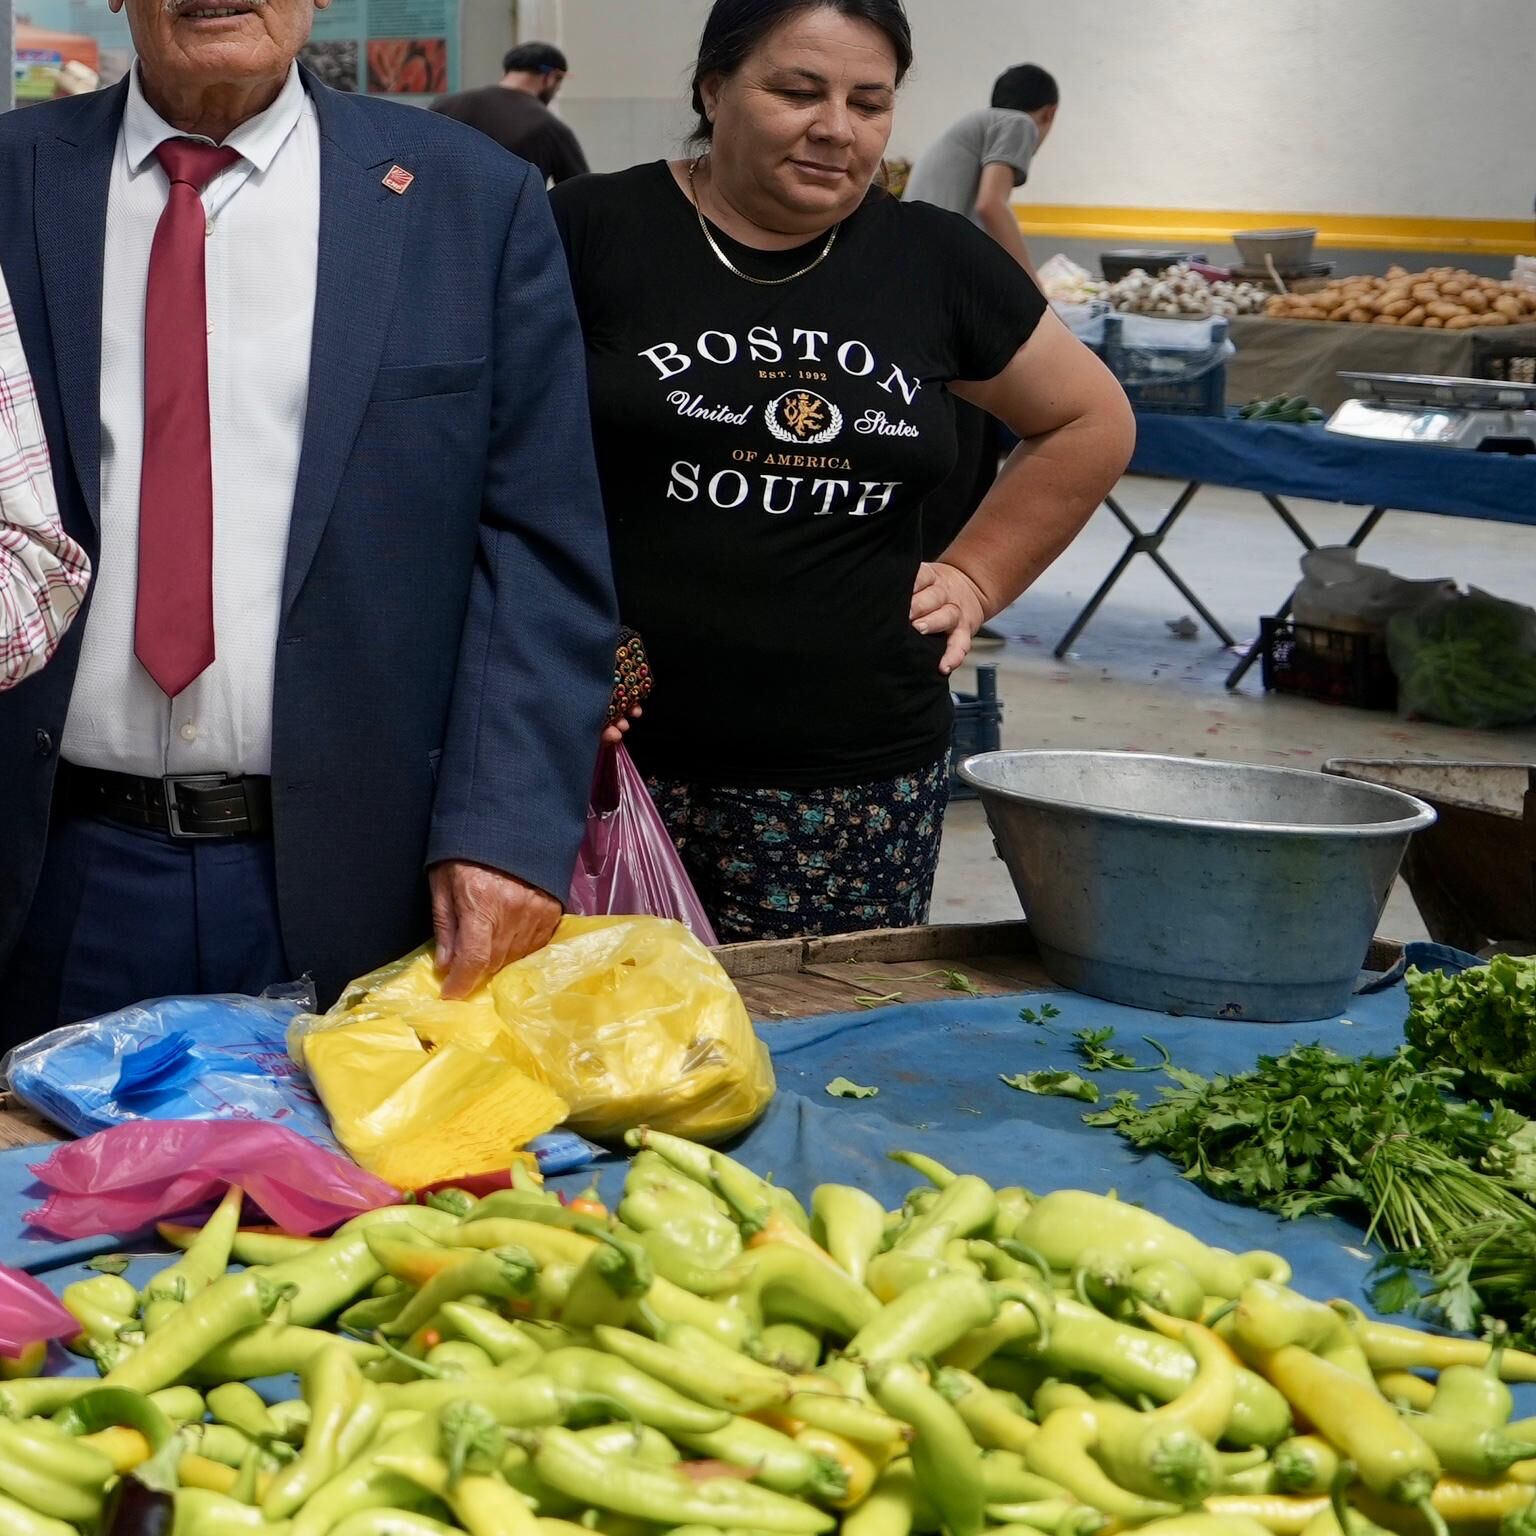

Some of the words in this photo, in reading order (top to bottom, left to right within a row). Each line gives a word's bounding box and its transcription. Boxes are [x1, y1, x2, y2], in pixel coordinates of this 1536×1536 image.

[638, 325, 922, 405] BOSTON
[758, 369, 792, 381] EST.
[798, 370, 828, 382] 1992
[666, 389, 753, 426] United
[854, 409, 919, 438] States
[732, 449, 758, 462] OF
[764, 452, 852, 470] AMERICA
[666, 460, 903, 516] SOUTH
